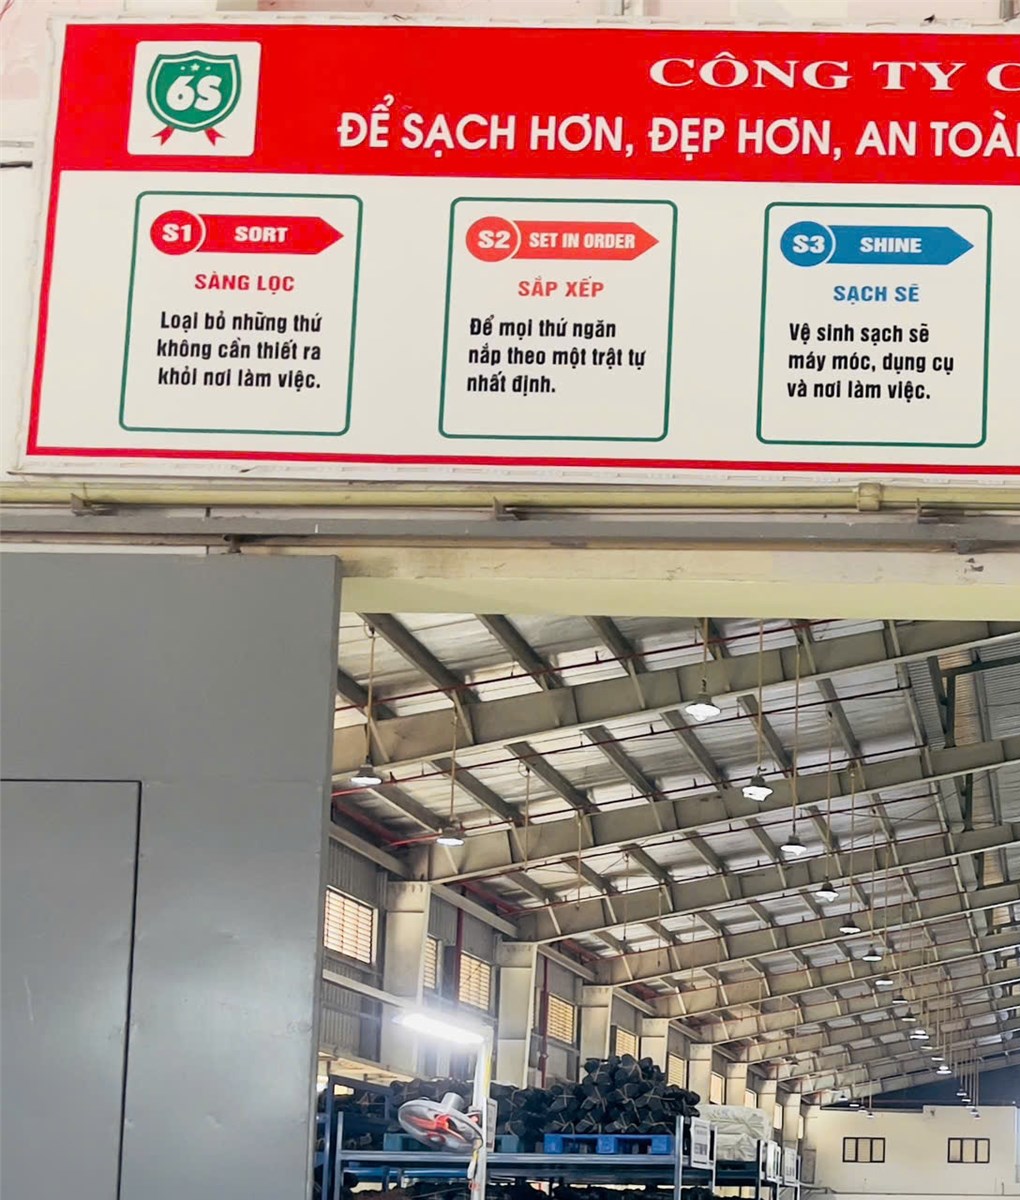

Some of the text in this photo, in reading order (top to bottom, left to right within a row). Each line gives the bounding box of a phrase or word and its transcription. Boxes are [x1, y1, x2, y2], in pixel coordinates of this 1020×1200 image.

[649, 51, 851, 91] CÔNG
[872, 61, 966, 92] TY
[166, 75, 222, 113] 6S
[337, 94, 395, 149] ĐỂ
[401, 113, 515, 159] SẠCH
[529, 114, 634, 157] HƠN,
[648, 115, 725, 161] ĐẸP
[737, 118, 843, 161] HƠN,
[855, 120, 917, 157] AN
[162, 224, 192, 243] S1
[234, 226, 288, 243] SORT
[478, 230, 511, 249] S2
[529, 233, 635, 249] SET IN ORDER
[792, 235, 825, 253] S3
[860, 237, 922, 253] SHINE
[195, 271, 294, 294] SÀNG LỌC
[518, 275, 604, 297] SẮP XẾP
[834, 284, 919, 305] SẠCH SẼ
[161, 311, 322, 333] Loại bỏ những thứ
[470, 314, 616, 340] Để mọi thứ ngăn
[789, 323, 929, 346] Vệ sinh sạch sẽ
[157, 337, 321, 360] không cần thiết ra
[469, 343, 646, 370] nắp theo một trật tự
[789, 351, 954, 375] máy móc, dụng cụ
[158, 366, 321, 391] khỏi nơi làm việc.
[467, 371, 556, 396] nhất định.
[787, 379, 930, 403] và nơi làm việc.
